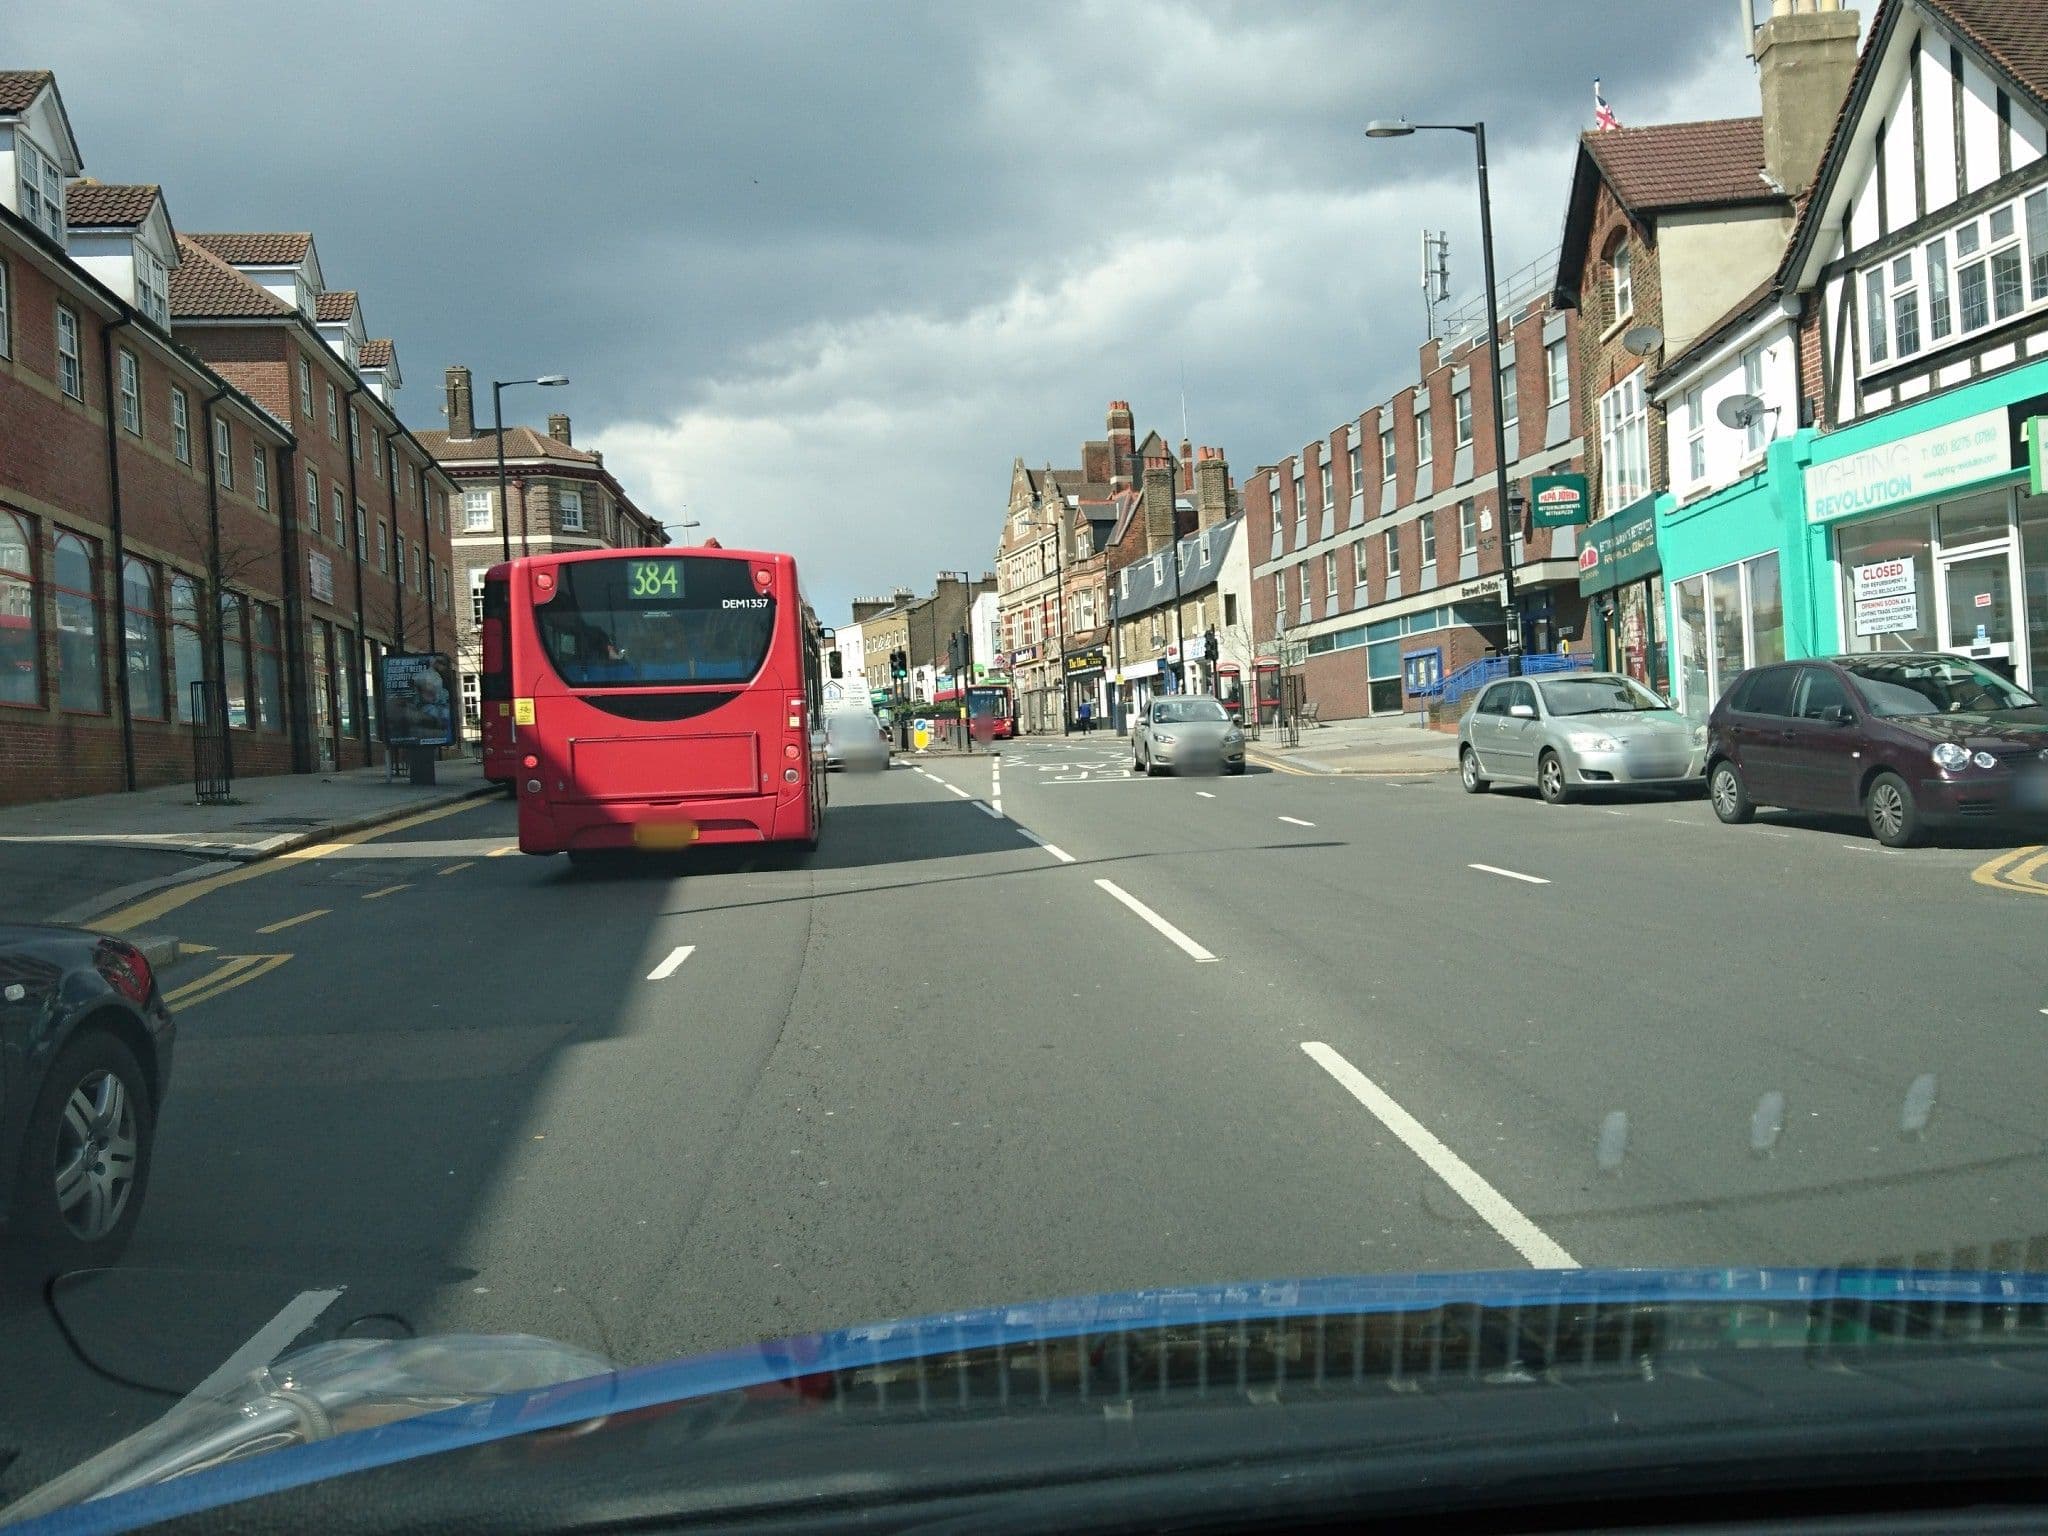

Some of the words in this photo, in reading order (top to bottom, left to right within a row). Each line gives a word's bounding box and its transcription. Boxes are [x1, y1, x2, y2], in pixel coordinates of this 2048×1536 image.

[1815, 474, 1912, 516] REVOLUTION
[1862, 563, 1904, 580] CLOSED
[632, 560, 678, 596] 384
[1879, 585, 1907, 594] RELOCATION
[722, 598, 769, 609] DEM1357
[1861, 601, 1884, 610] OPENING
[1884, 598, 1900, 607] SOON
[1892, 605, 1912, 613] COUNTER
